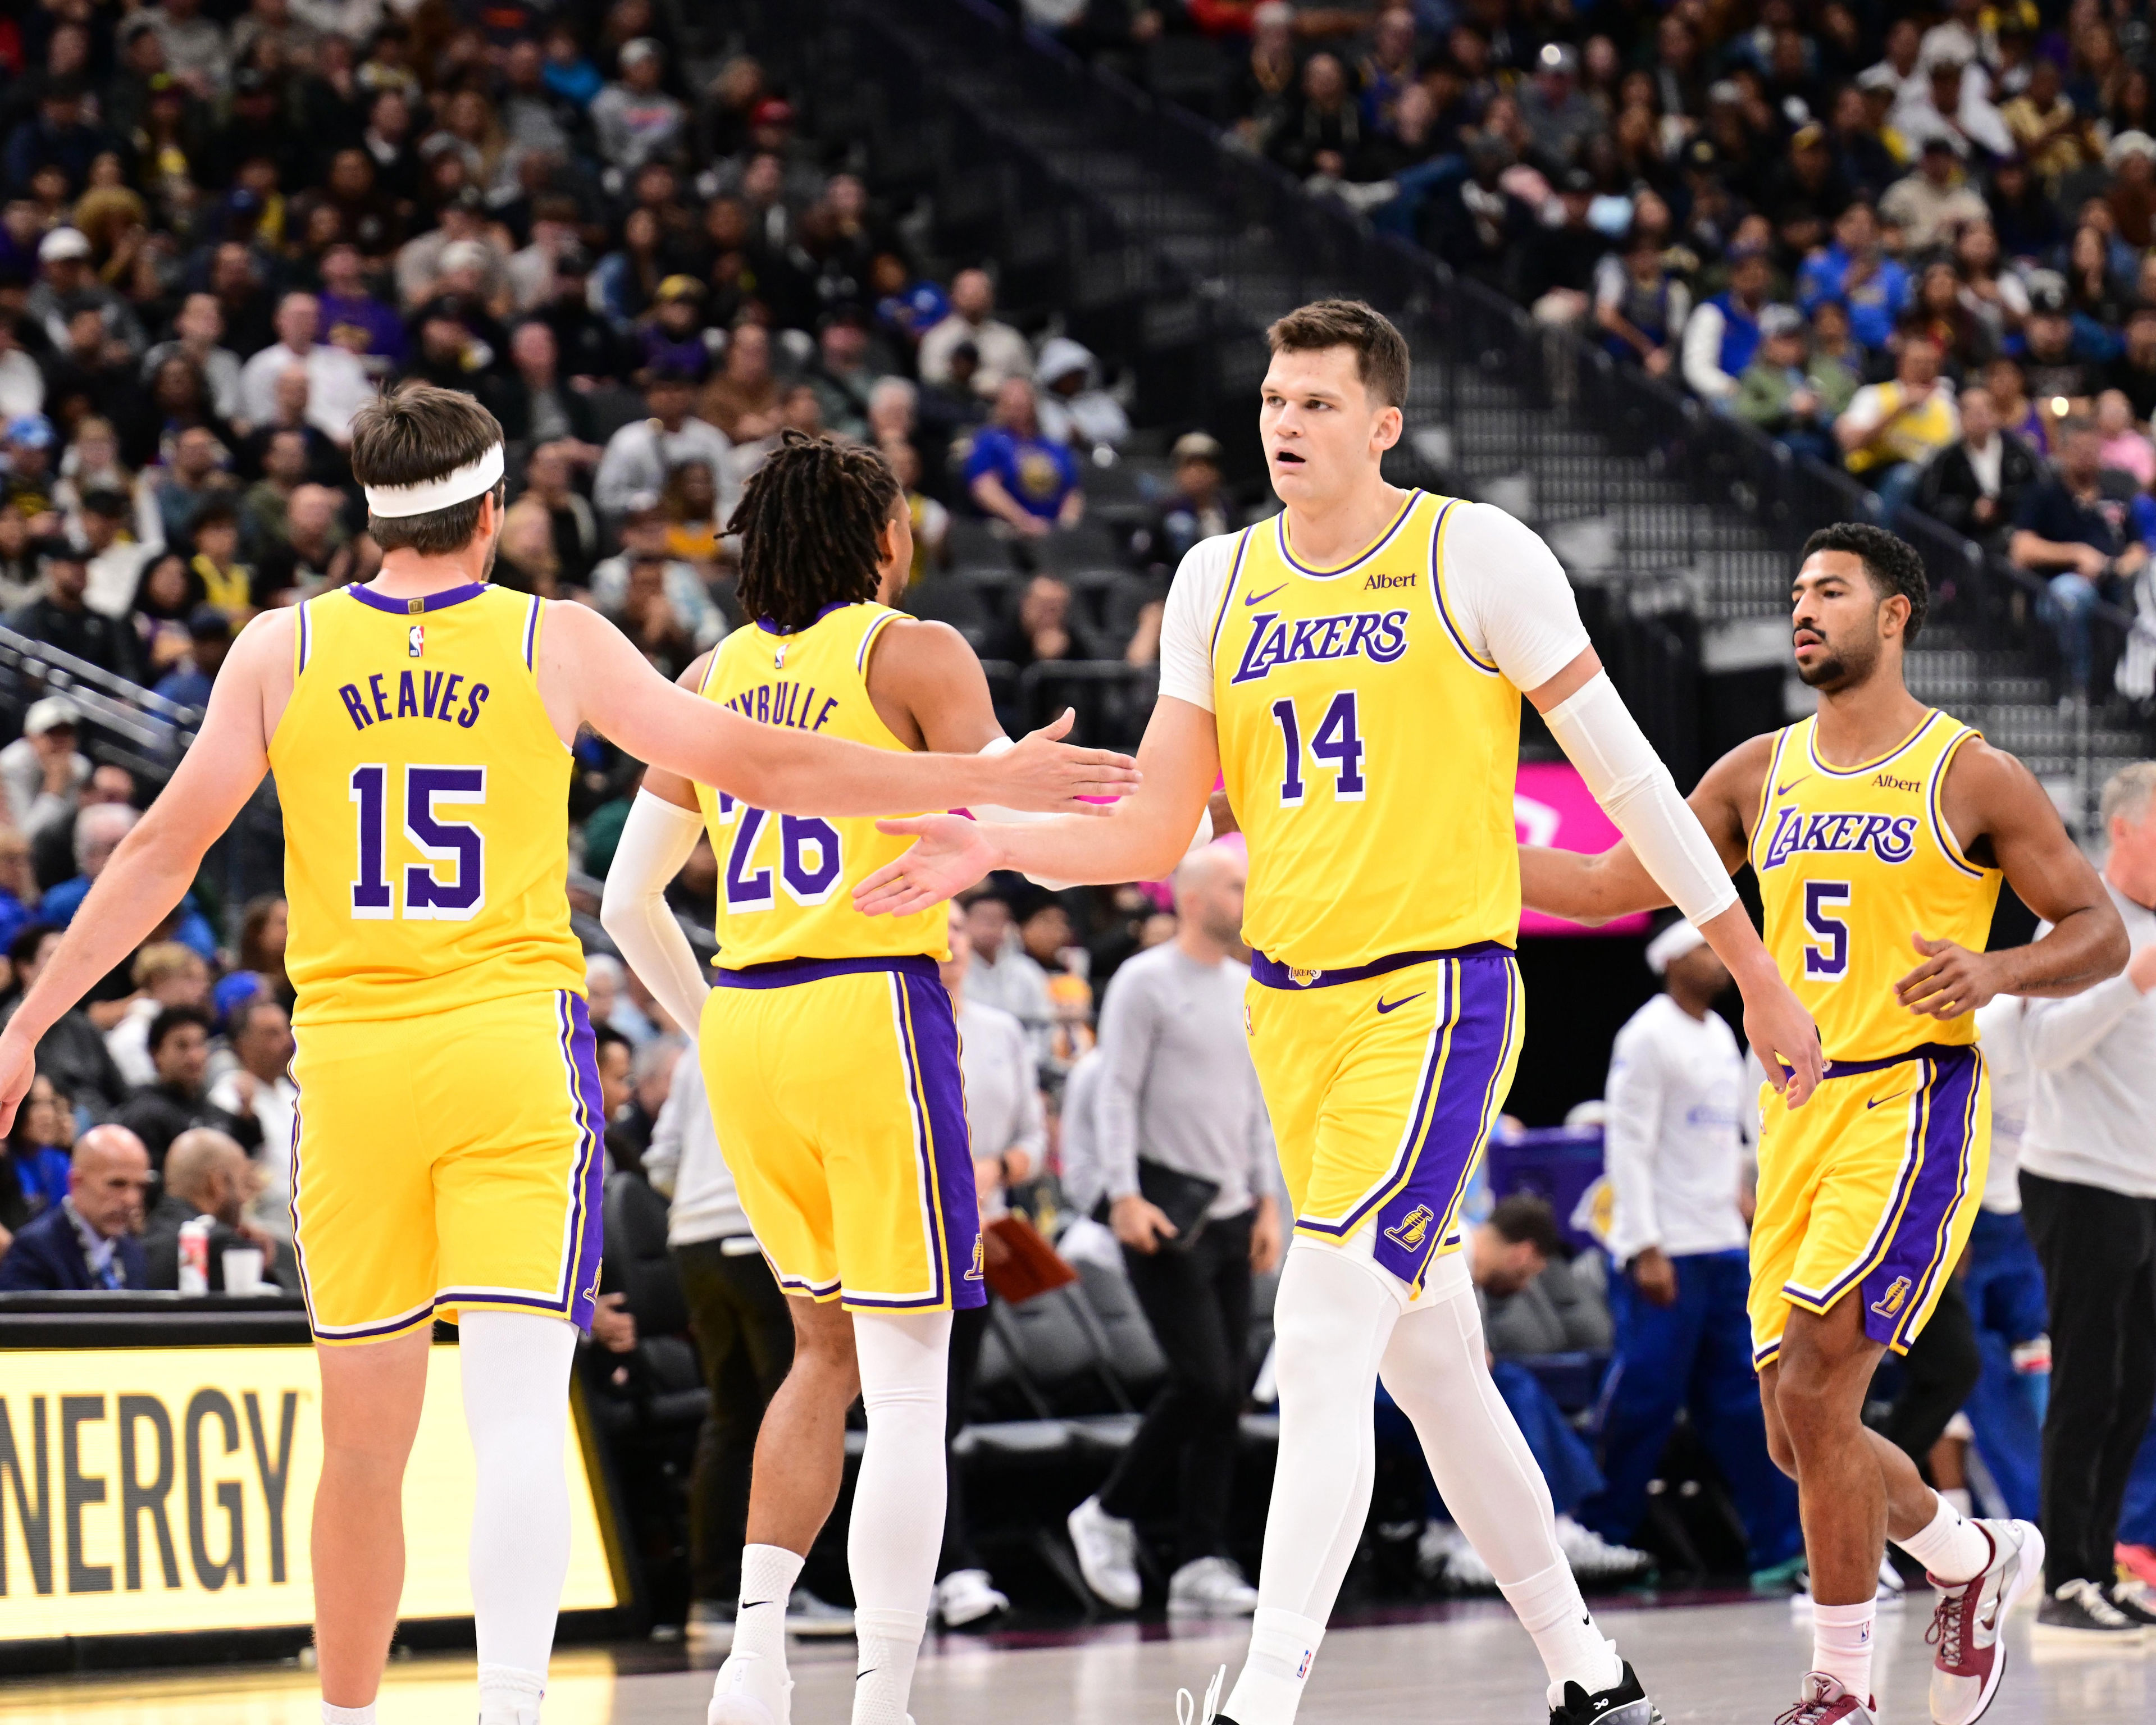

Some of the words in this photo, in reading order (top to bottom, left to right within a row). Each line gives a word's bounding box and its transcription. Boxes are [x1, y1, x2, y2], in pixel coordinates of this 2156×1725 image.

[1364, 573, 1417, 590] Albert
[1230, 608, 1411, 686] LAKERS
[338, 670, 489, 731] REAVES
[724, 682, 838, 732] YBULLE
[1270, 689, 1365, 808] 14
[1871, 774, 1921, 793] Albert
[349, 763, 487, 921] 15
[717, 789, 844, 915] 26
[1762, 803, 1920, 871] LAKERS
[1803, 879, 1851, 982] 5
